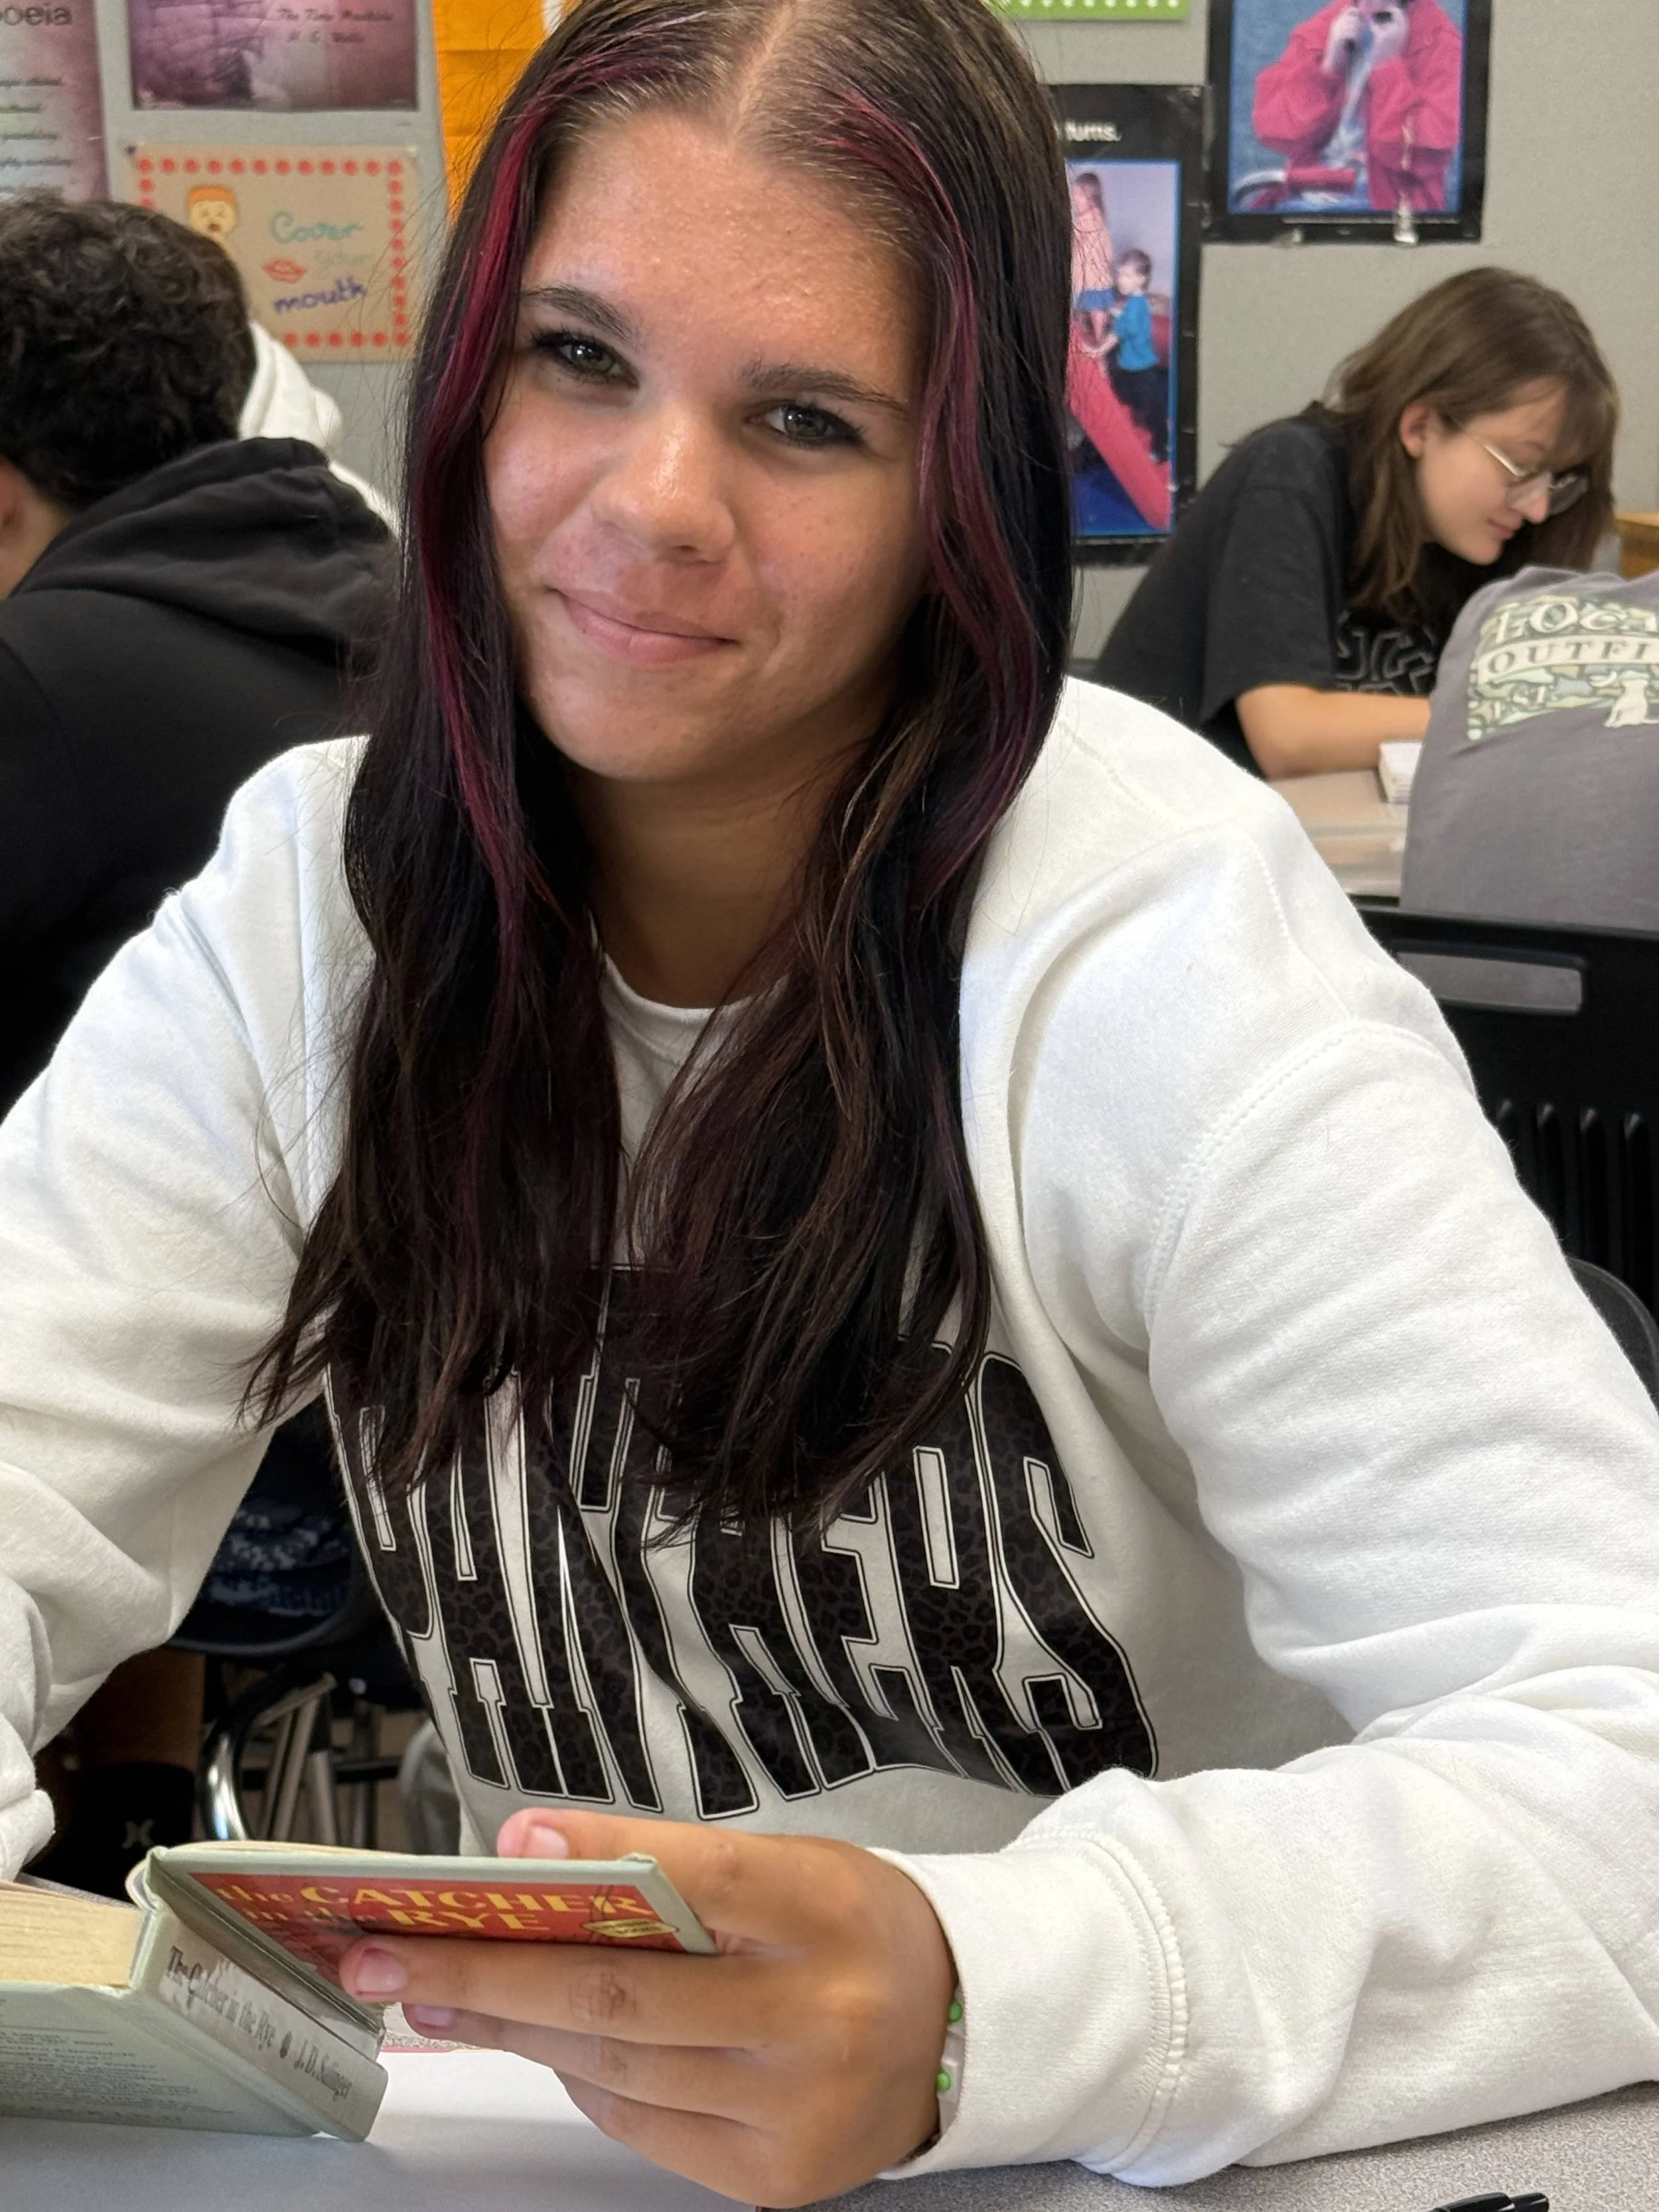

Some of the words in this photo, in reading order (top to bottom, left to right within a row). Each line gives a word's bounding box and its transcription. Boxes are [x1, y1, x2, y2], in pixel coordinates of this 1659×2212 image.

[0, 2, 72, 27] oeia
[300, 1885, 653, 1915] CATCHER
[387, 1909, 550, 1931] RYE
